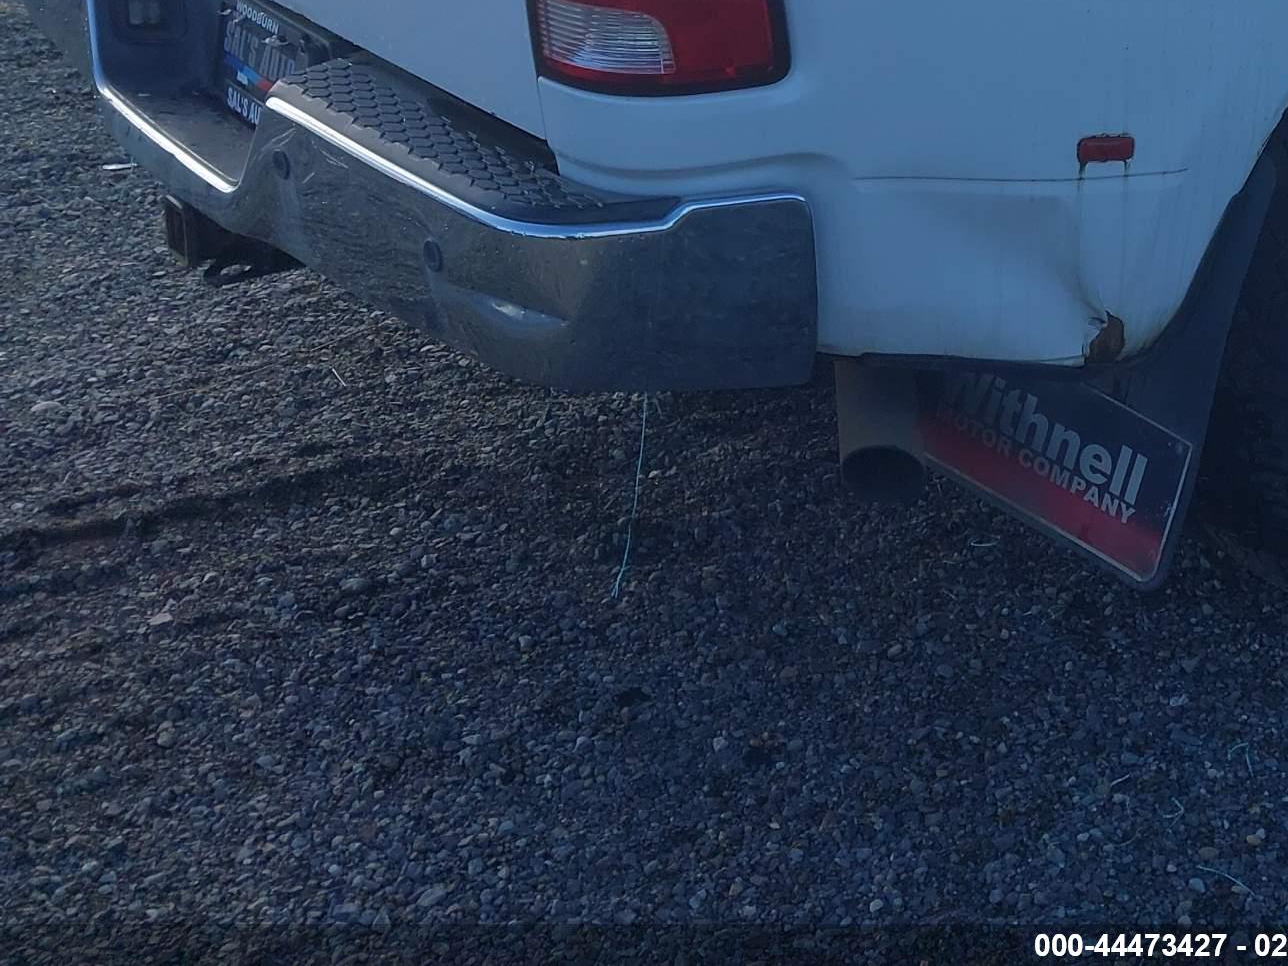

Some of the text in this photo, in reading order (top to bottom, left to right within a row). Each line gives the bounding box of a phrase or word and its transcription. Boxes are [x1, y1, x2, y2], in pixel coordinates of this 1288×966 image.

[224, 19, 259, 68] SAL'S
[226, 86, 249, 117] SAL'S
[1018, 448, 1137, 524] COMPANY
